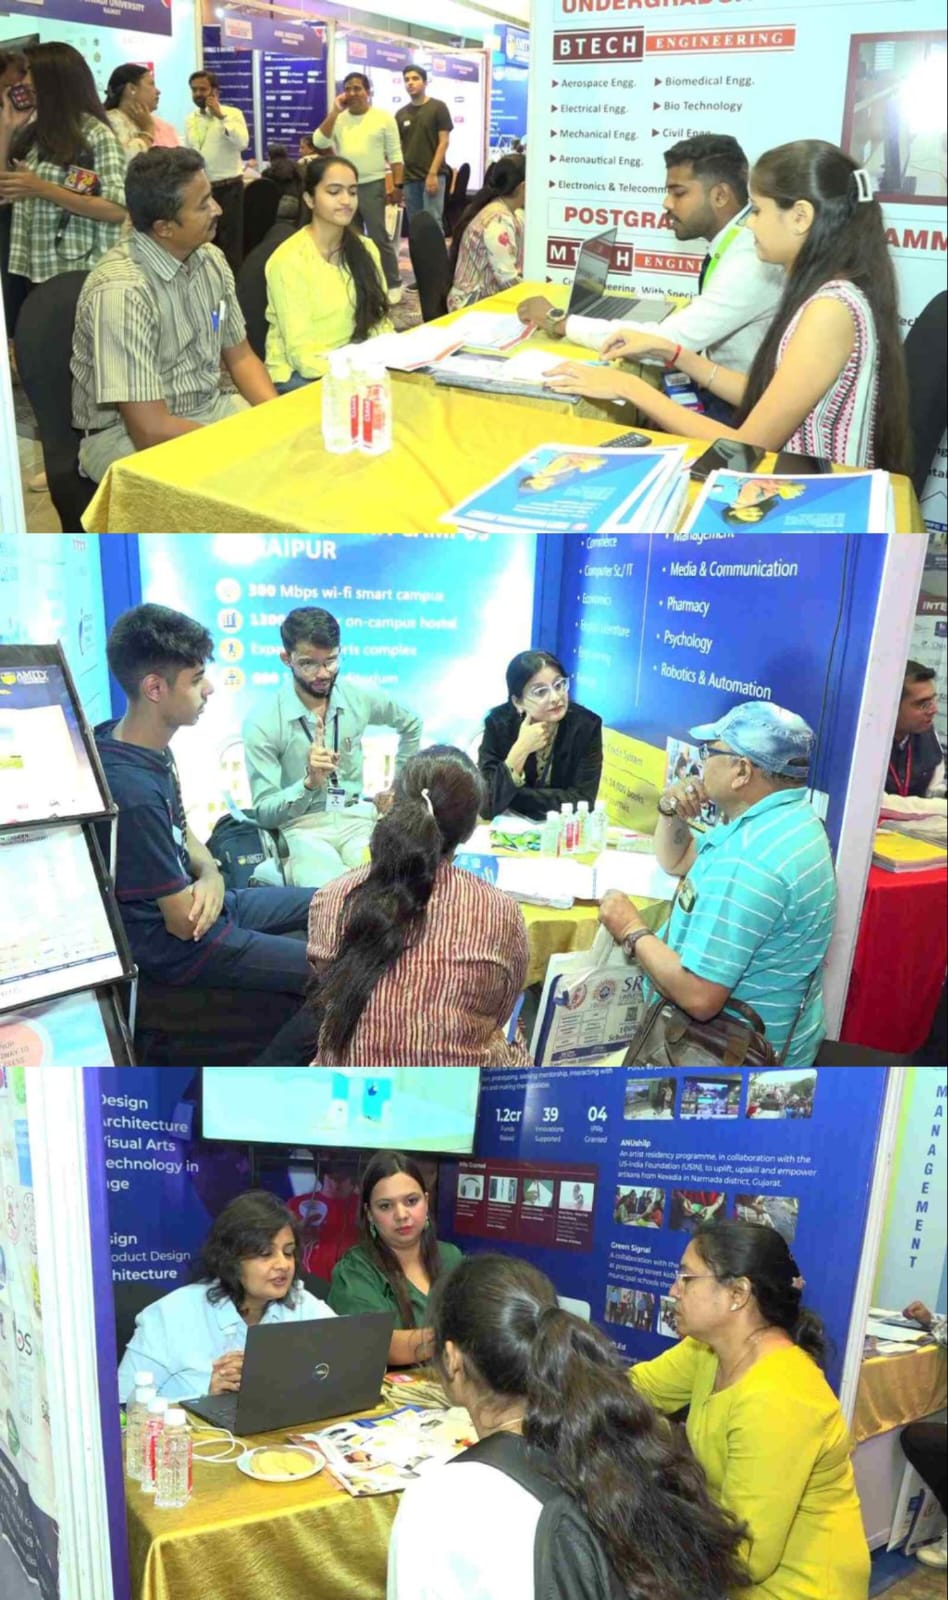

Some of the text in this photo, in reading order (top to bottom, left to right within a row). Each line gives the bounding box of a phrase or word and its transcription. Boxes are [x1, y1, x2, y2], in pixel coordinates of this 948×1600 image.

[562, 0, 752, 14] UNDERG
[560, 32, 784, 56] BTECH ENGINEERING
[561, 78, 636, 90] Aerospace Engg.
[665, 76, 755, 87] Biomedical Engg.
[560, 104, 629, 115] Electrical Engg.
[664, 101, 742, 112] Bio Technology
[560, 129, 639, 141] Mechanical Engg.
[662, 129, 683, 137] Civil
[559, 154, 644, 167] Aeronautical Engg.
[558, 180, 669, 193] Electronics & Telecomm
[564, 206, 947, 251] POSTGRA AMM
[266, 539, 337, 560] AIPUR
[670, 558, 798, 577] Media & Communication
[280, 584, 318, 599] Mbps
[322, 585, 352, 598] wi-fi
[355, 587, 392, 600] smart
[396, 590, 445, 602] campus
[667, 596, 710, 618] Pharmacy
[664, 630, 713, 654] Psychology
[661, 662, 771, 700] Robotics & Automation
[496, 1108, 522, 1122] 1.2cr
[543, 1107, 559, 1122] 39
[588, 1106, 608, 1122] 04
[104, 1137, 176, 1152] isual Arts
[645, 1151, 674, 1159] residency
[675, 1152, 717, 1160] programme,
[727, 1153, 775, 1162] collaboration
[777, 1154, 795, 1163] with
[796, 1155, 811, 1163] the
[105, 1158, 199, 1174] echnology in
[644, 1161, 680, 1169] Foundation
[735, 1165, 759, 1174] upskill
[777, 1169, 817, 1177] empower
[640, 1171, 657, 1179] from
[691, 1175, 722, 1183] Narmada
[751, 1178, 782, 1187] Gujarat.
[111, 1250, 191, 1265] oduct Design
[112, 1268, 178, 1281] hitecture
